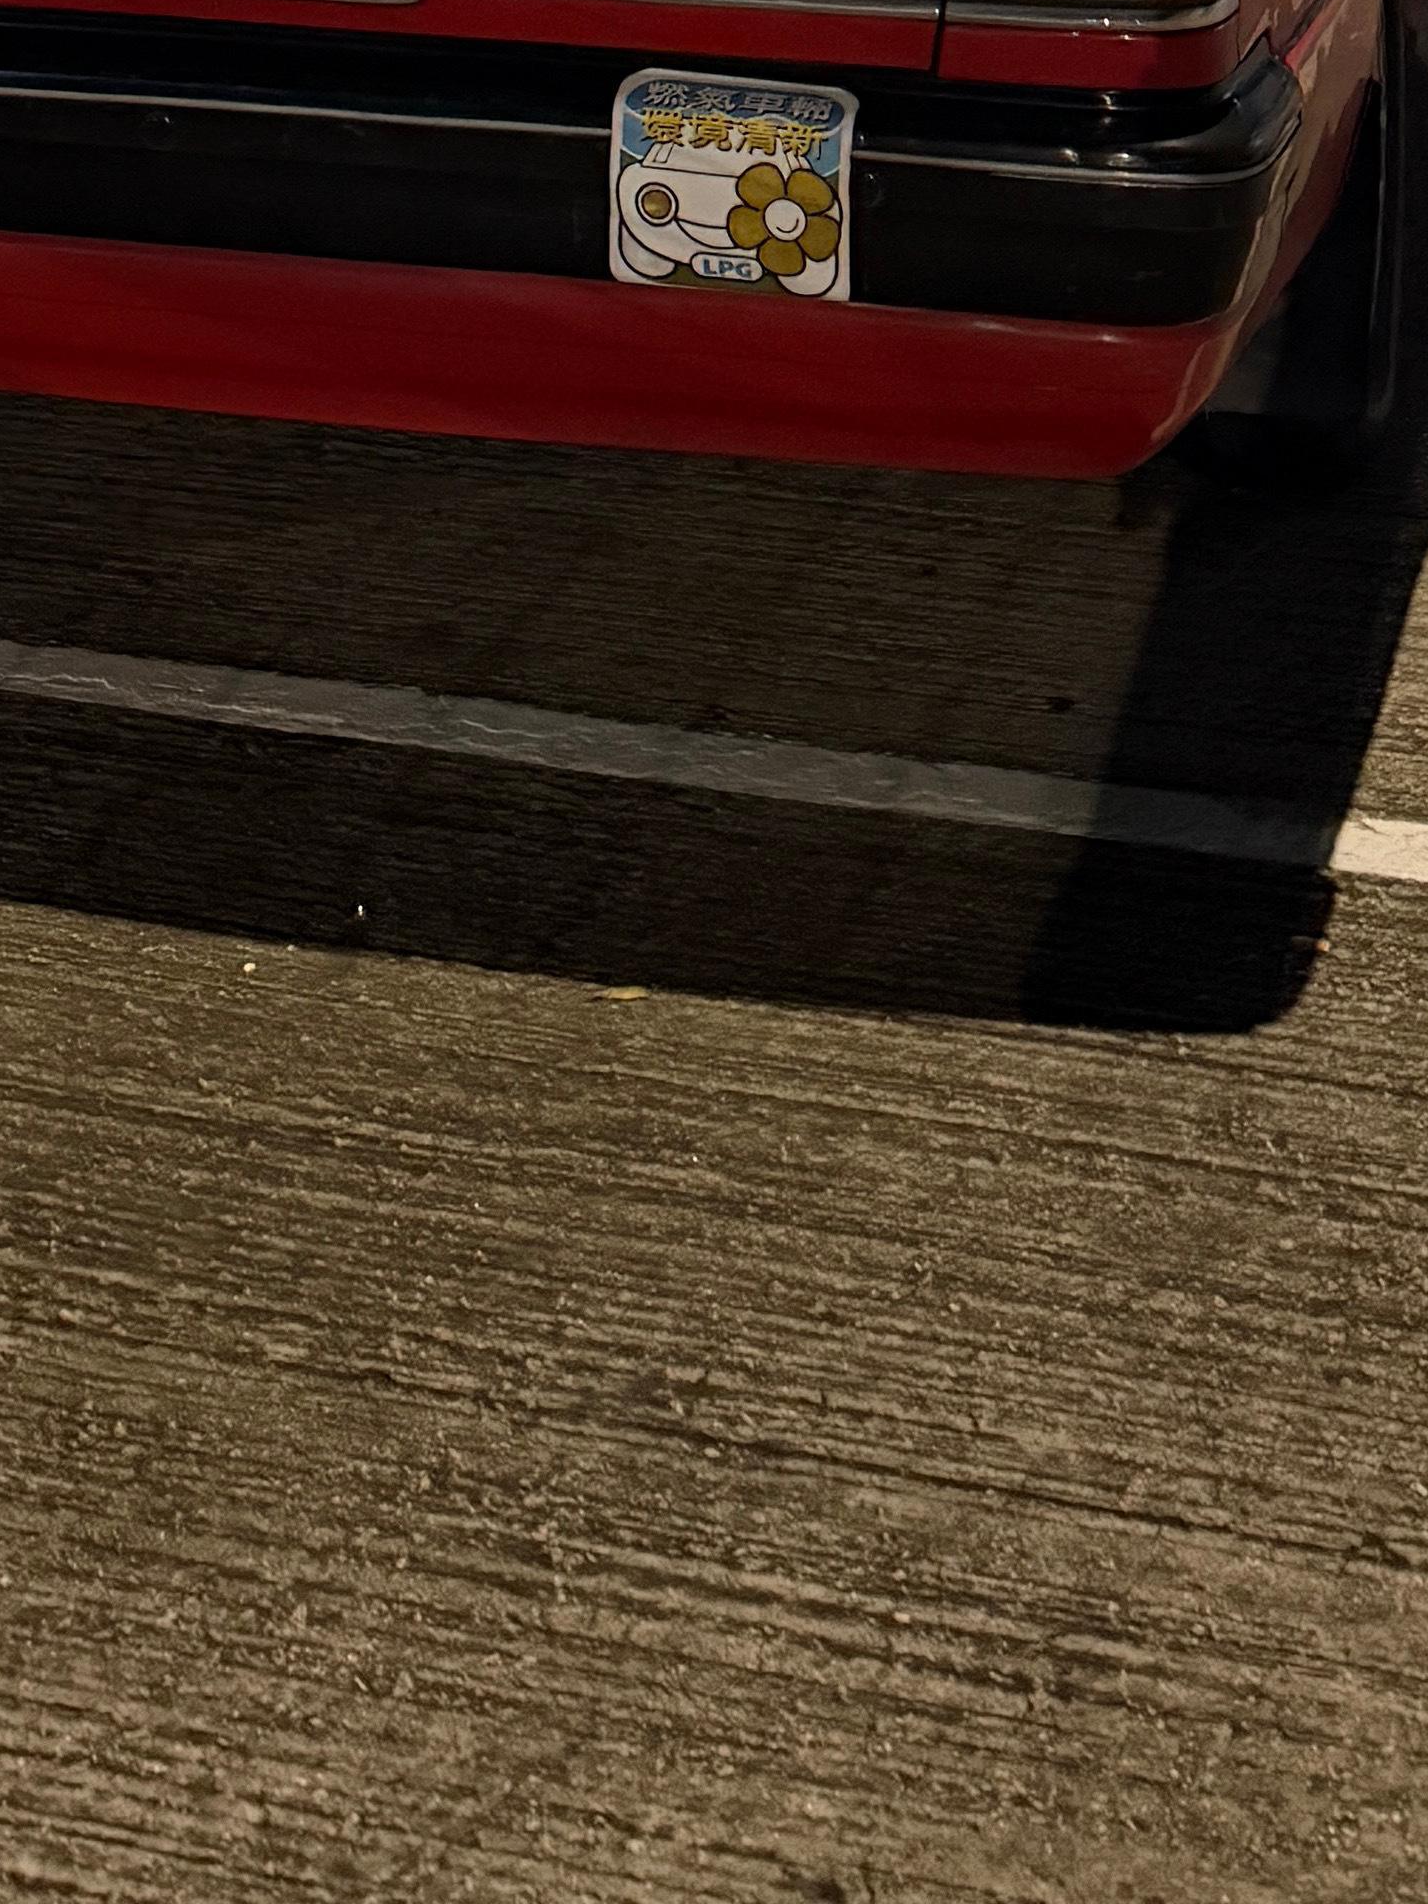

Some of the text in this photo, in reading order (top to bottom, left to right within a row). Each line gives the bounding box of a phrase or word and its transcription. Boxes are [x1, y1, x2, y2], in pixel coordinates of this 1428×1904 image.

[642, 80, 834, 121] 燃氣車輛
[641, 106, 829, 161] 環境清新
[702, 258, 755, 279] LPG
